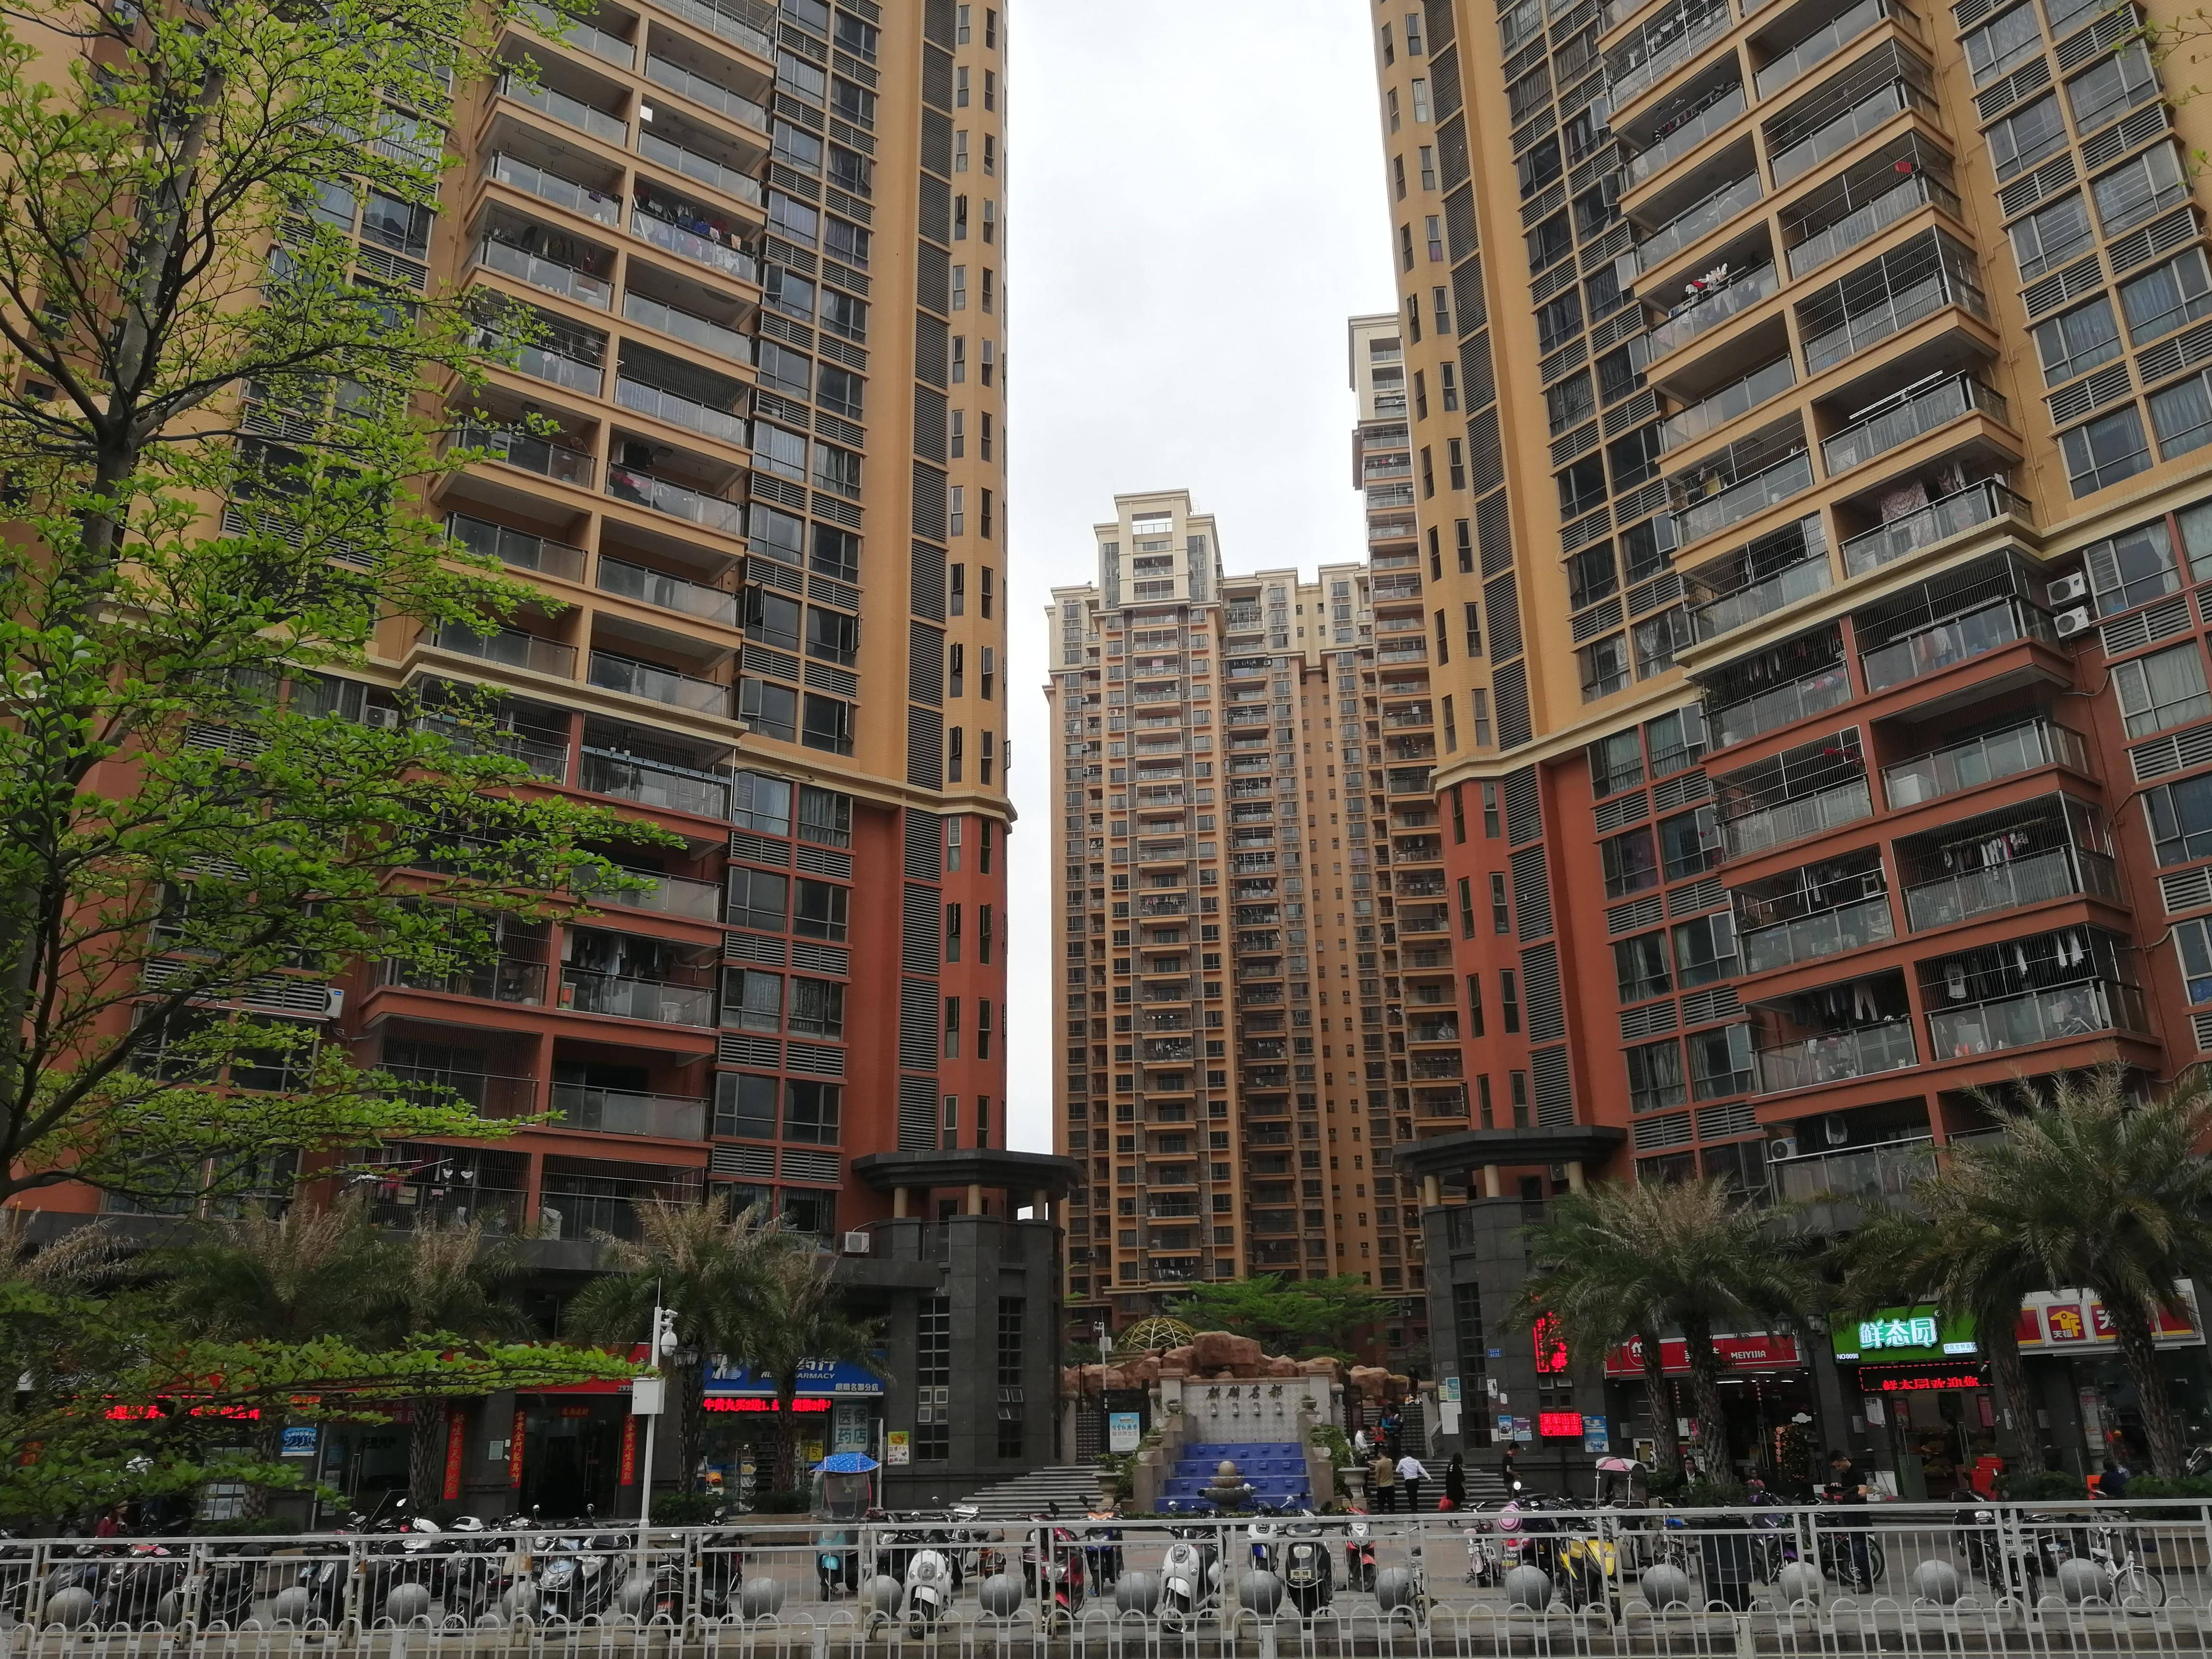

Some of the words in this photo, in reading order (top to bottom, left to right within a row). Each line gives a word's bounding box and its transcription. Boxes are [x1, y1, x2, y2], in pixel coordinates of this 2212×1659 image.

[1859, 1317, 1938, 1349] 鲜态园
[2053, 1330, 2073, 1338] 天福
[1731, 1350, 1767, 1359] MEIYIJIA
[1205, 1384, 1283, 1400] 麒麟名都
[838, 1408, 866, 1425] 医保
[838, 1427, 866, 1444] 药店
